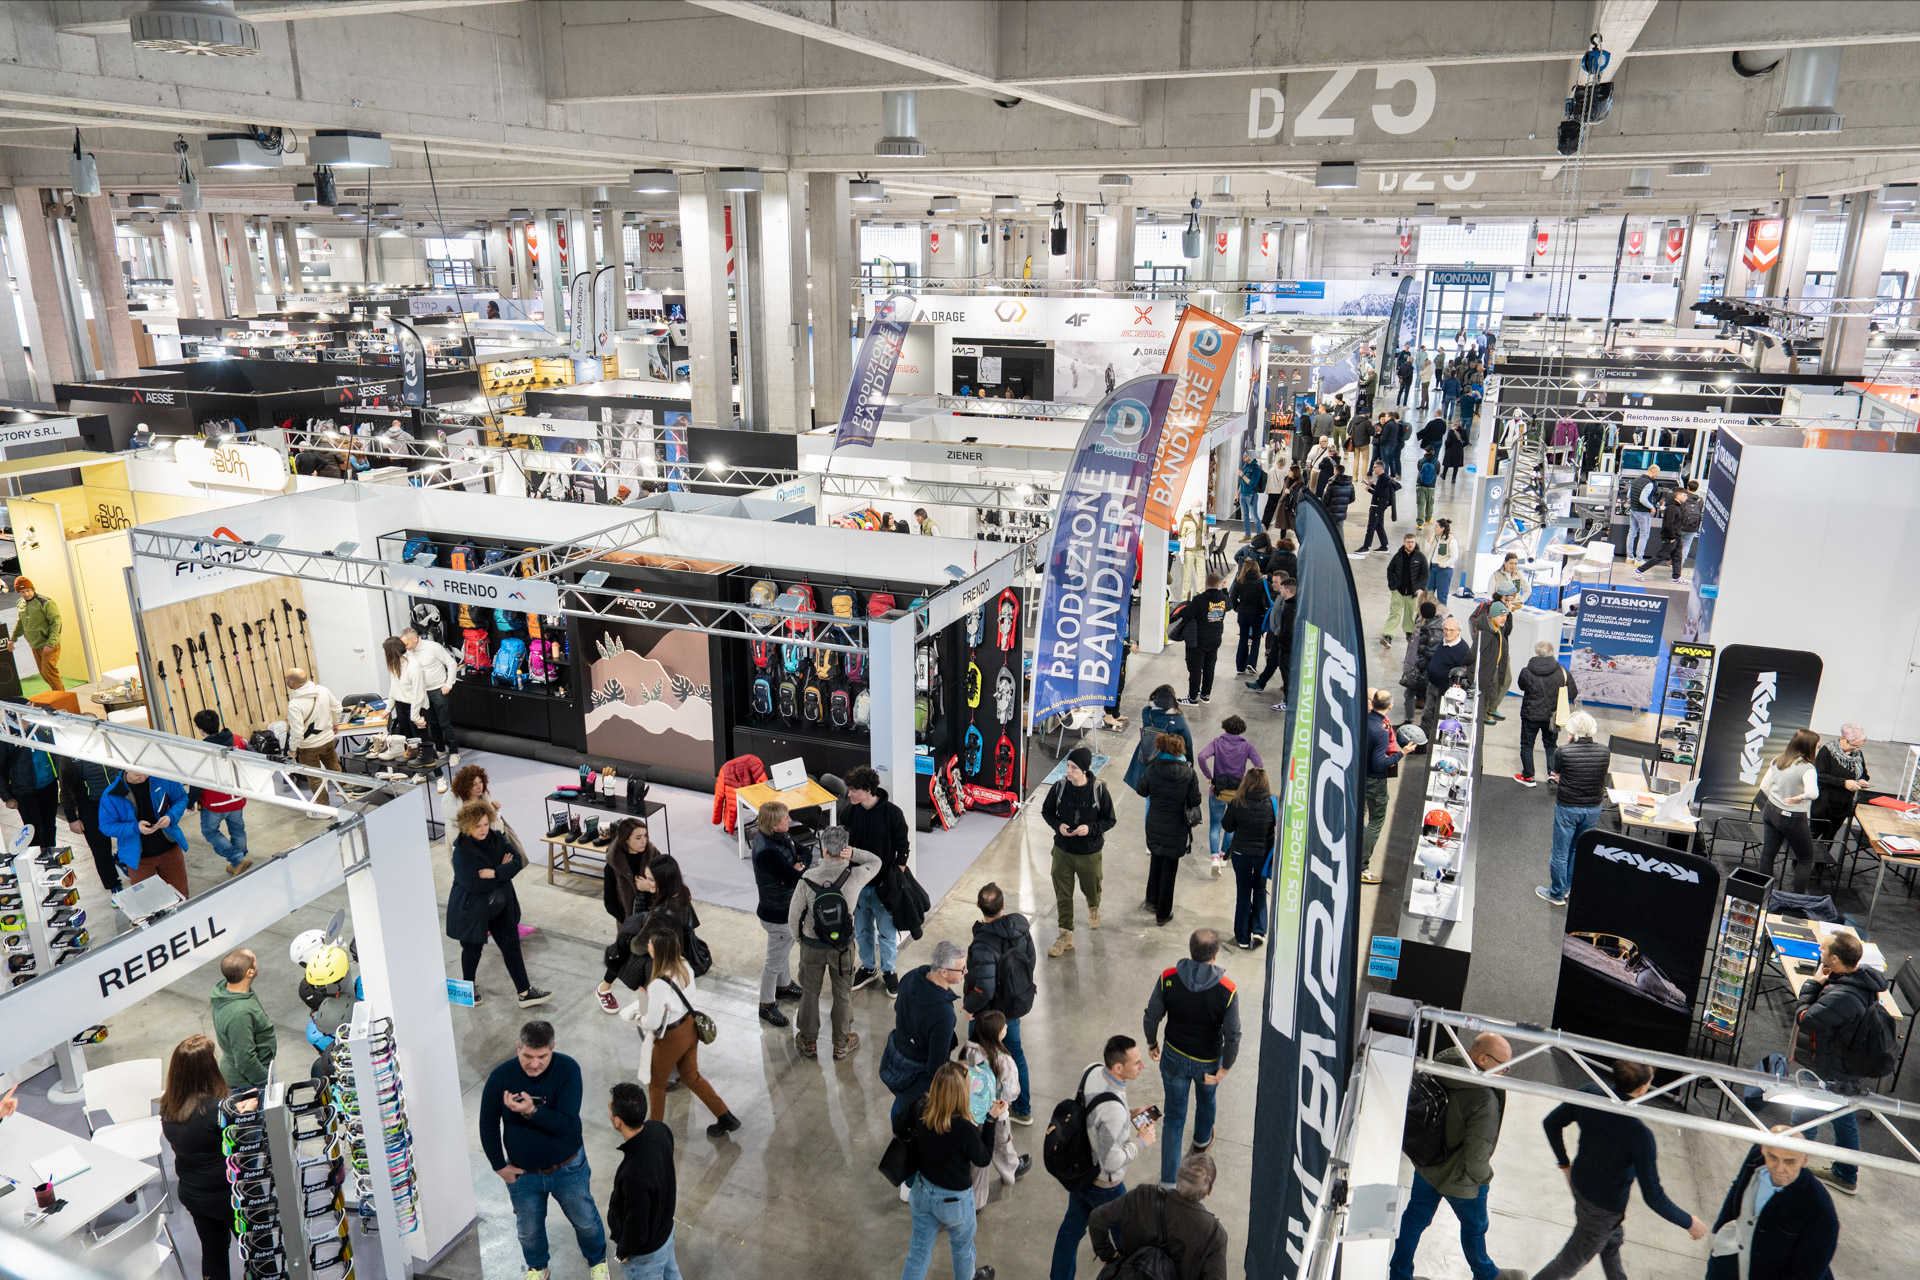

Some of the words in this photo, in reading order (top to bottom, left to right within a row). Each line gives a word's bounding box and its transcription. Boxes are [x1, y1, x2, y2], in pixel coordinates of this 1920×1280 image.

[1434, 272, 1489, 284] MONTANA
[931, 311, 965, 322] ORAGE
[1065, 313, 1090, 327] 4F
[1144, 348, 1167, 356] ORAGE
[1187, 350, 1217, 371] Domina
[502, 367, 534, 377] GARSPORT
[852, 325, 889, 427] PRODUZIONE
[861, 330, 900, 433] BANDIERE
[357, 384, 387, 396] AESSE
[146, 392, 175, 405] AESSE
[1626, 414, 1670, 423] Reichmann
[1693, 416, 1715, 425] Board
[1717, 417, 1746, 426] Tuning
[34, 427, 62, 437] S.R.L.
[542, 423, 556, 432] TSL
[1153, 371, 1214, 508] BANDIERE
[947, 450, 983, 461] ZIENER
[1094, 441, 1148, 464] Domina
[1050, 466, 1107, 680] PRODUZIONE
[1078, 471, 1142, 685] BANDIERE
[444, 579, 498, 599] FRENDO
[962, 577, 991, 607] FRENDO
[1601, 596, 1662, 609] ITASNOW
[1594, 618, 1632, 627] INSURANCE
[1594, 633, 1654, 644] SKIVERSICHERUNG
[1626, 632, 1654, 640] EINFACH
[1674, 646, 1712, 657] KAYAK
[1739, 671, 1777, 786] KAYAK
[1593, 843, 1700, 885] KAYAK
[1373, 943, 1396, 951] D25/04
[99, 916, 227, 998] REBELL
[1370, 964, 1393, 973] D25/04
[235, 1114, 256, 1124] Rebell
[298, 1131, 317, 1140] Rebell
[239, 1142, 261, 1152] Rebell
[243, 1169, 265, 1179] Rebell
[248, 1196, 270, 1206] Rebell
[307, 1206, 327, 1217] Rebell
[252, 1222, 274, 1232] Rebell
[254, 1249, 275, 1259] Rebell
[315, 1259, 334, 1270] Rebell
